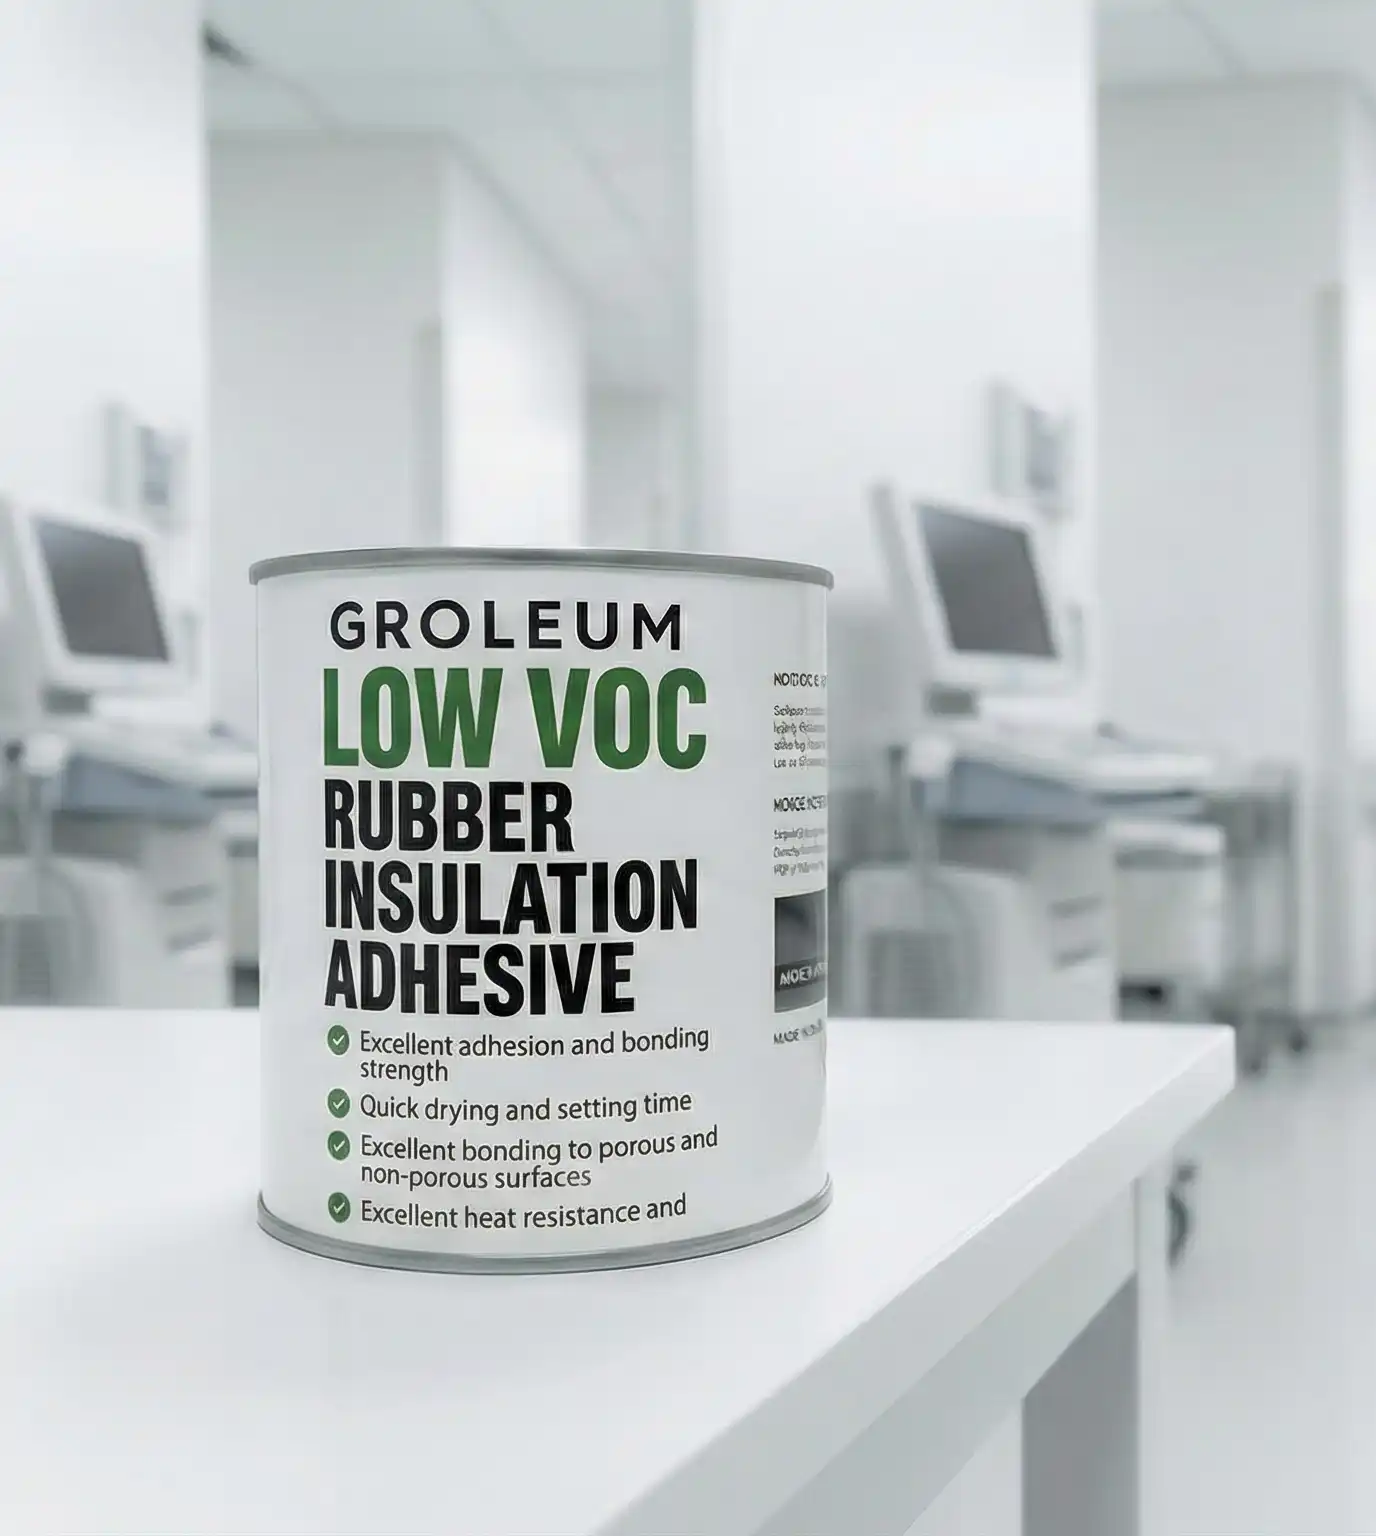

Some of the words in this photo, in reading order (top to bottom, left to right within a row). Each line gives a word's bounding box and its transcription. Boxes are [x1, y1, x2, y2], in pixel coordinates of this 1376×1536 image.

[330, 599, 681, 651] GROLEUM
[323, 665, 504, 770] LOW
[525, 666, 707, 770] VOC
[324, 778, 575, 853] RUBBER
[324, 858, 698, 935] INSULATION
[324, 938, 635, 1017] ADHESIVE
[360, 1030, 454, 1057] Excellent
[458, 1033, 564, 1057] adhesion
[571, 1030, 615, 1056] and
[622, 1026, 709, 1053] bonding
[360, 1060, 448, 1087] strength
[360, 1093, 420, 1120] Quick
[424, 1097, 499, 1127] drying
[505, 1097, 550, 1122] and
[557, 1096, 637, 1123] setting
[643, 1092, 692, 1115] time
[361, 1134, 456, 1162] Excellent
[462, 1138, 561, 1166] bonding
[567, 1139, 593, 1160] to
[599, 1135, 676, 1164] porous
[680, 1125, 718, 1151] and
[361, 1166, 488, 1192] non-porous
[494, 1164, 592, 1189] surfaces
[361, 1199, 459, 1229] Excellent
[464, 1205, 517, 1229] heat
[523, 1204, 641, 1229] resistance
[646, 1192, 687, 1220] and
